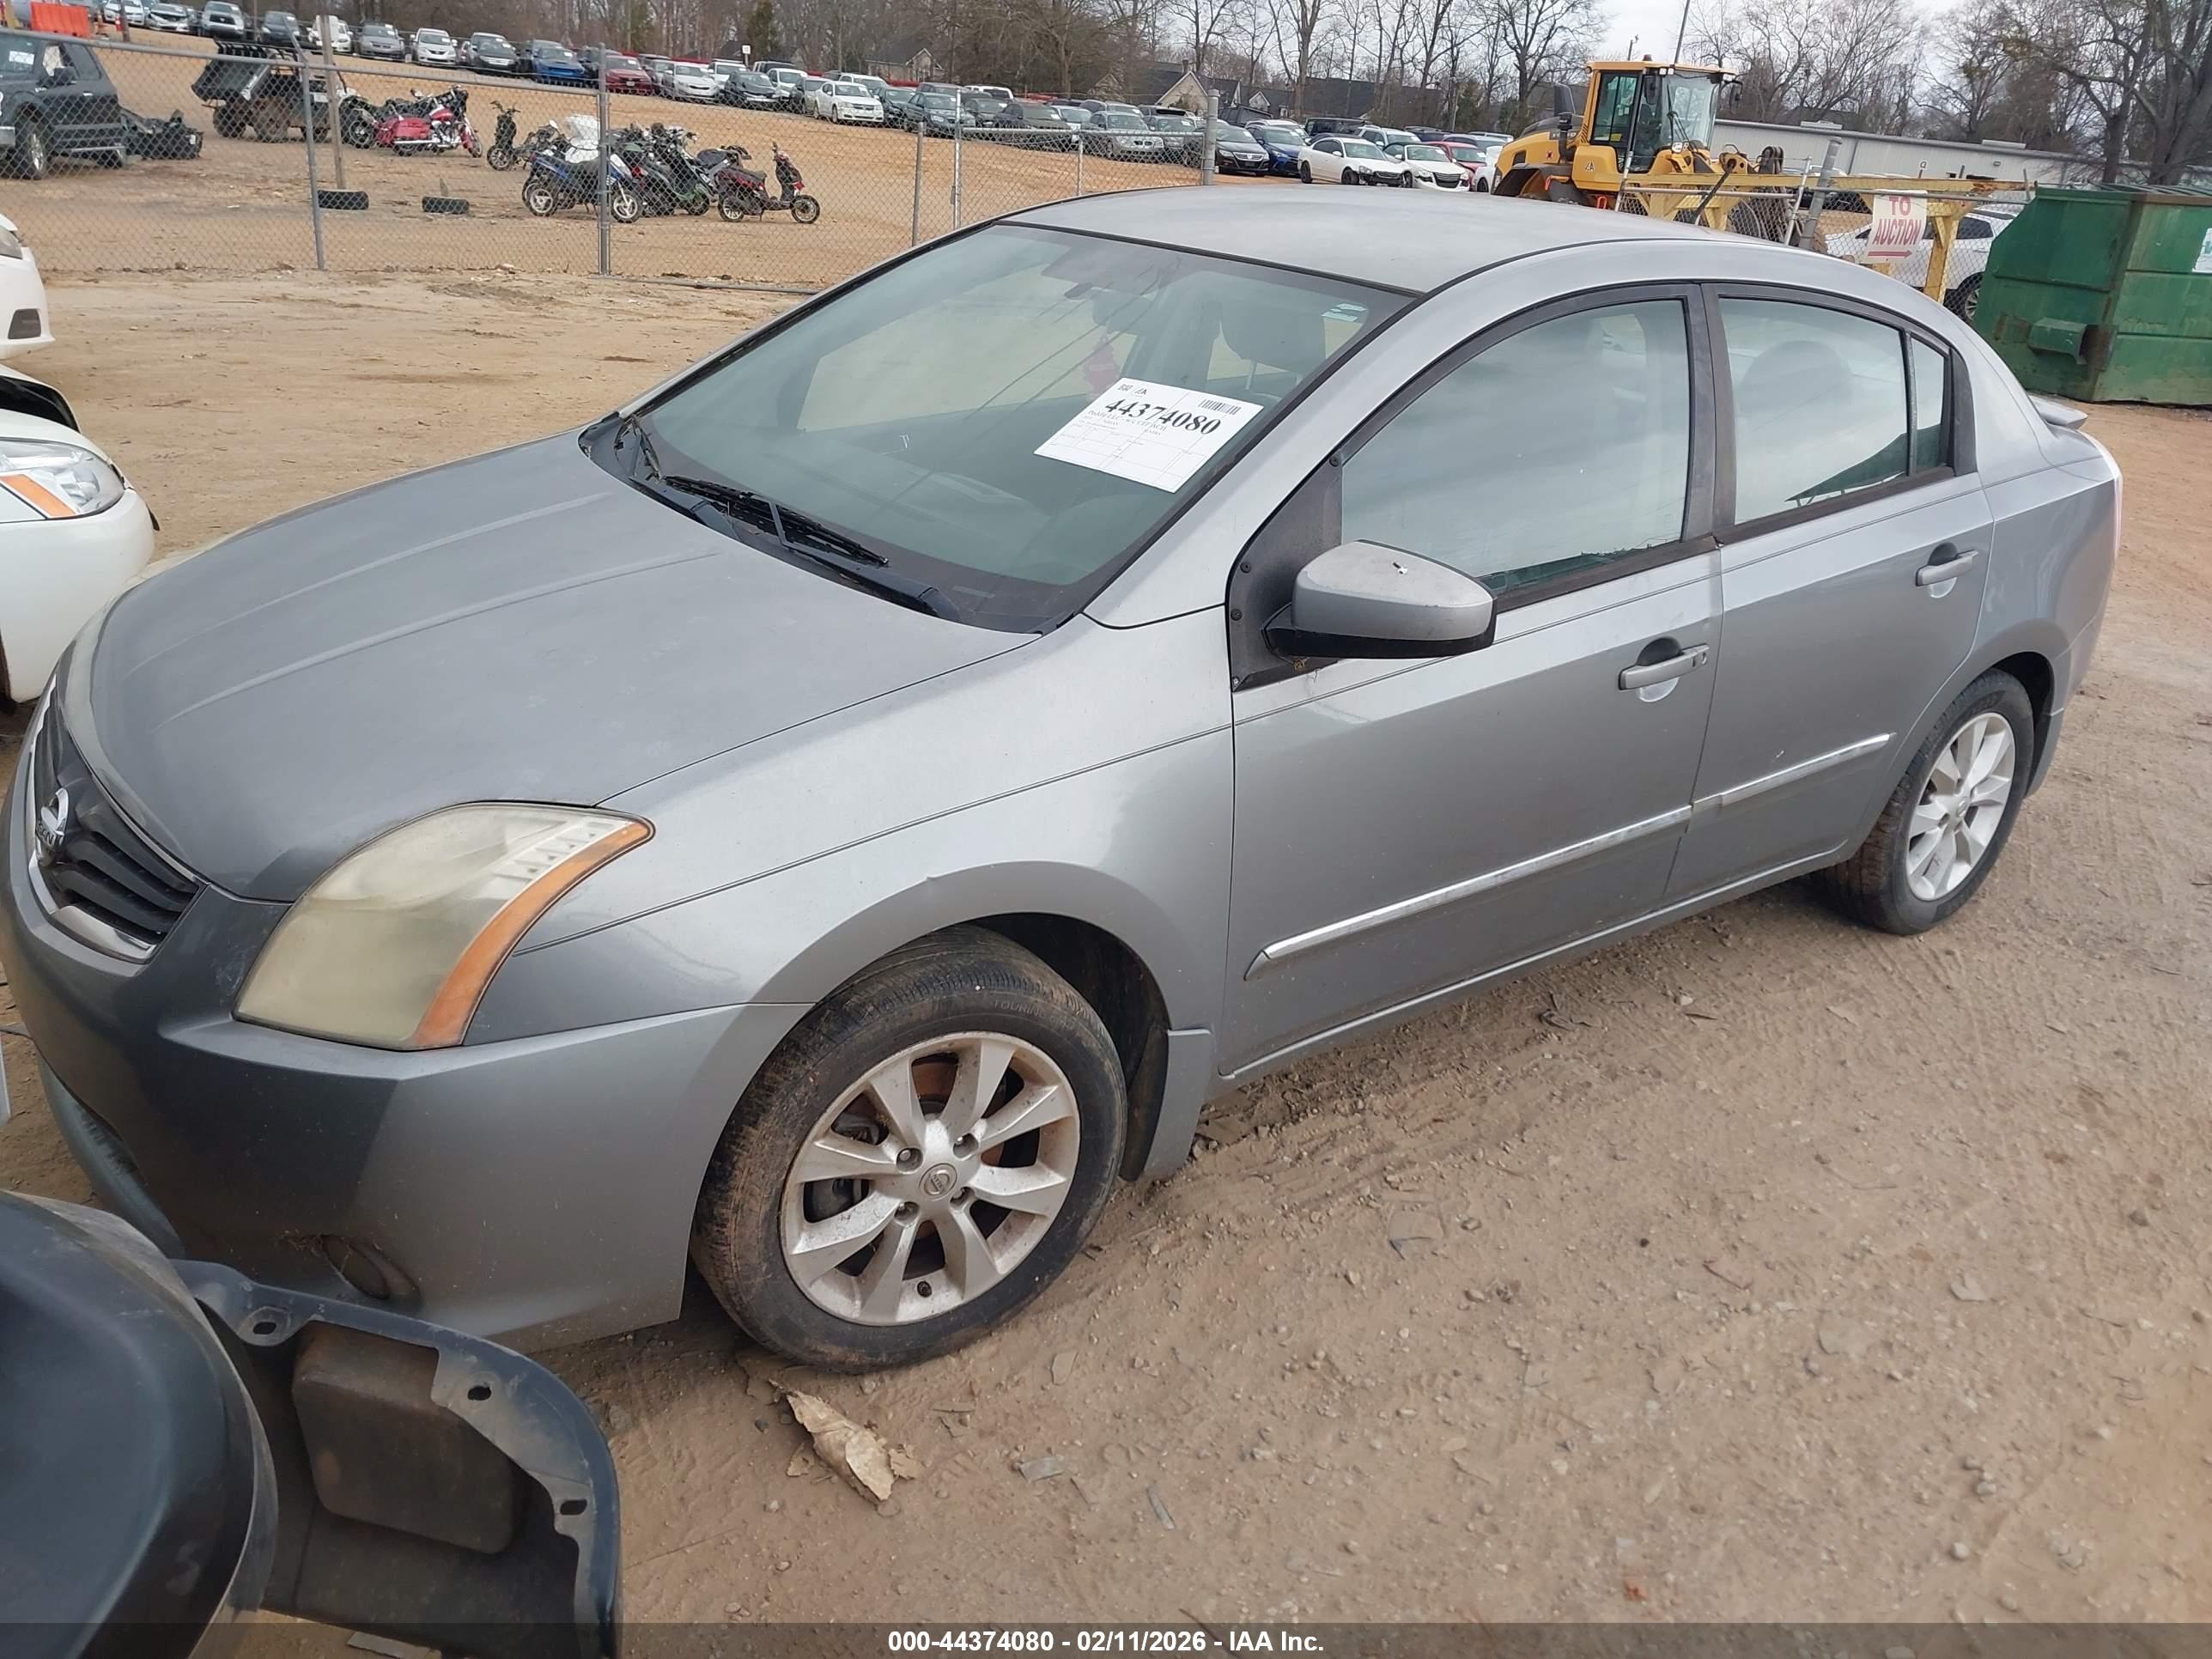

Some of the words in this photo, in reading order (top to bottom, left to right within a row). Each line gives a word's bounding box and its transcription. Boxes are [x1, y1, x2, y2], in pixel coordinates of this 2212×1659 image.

[1889, 196, 1911, 216] TO
[1873, 218, 1922, 245] AUCTION
[1104, 398, 1221, 434] 44374080
